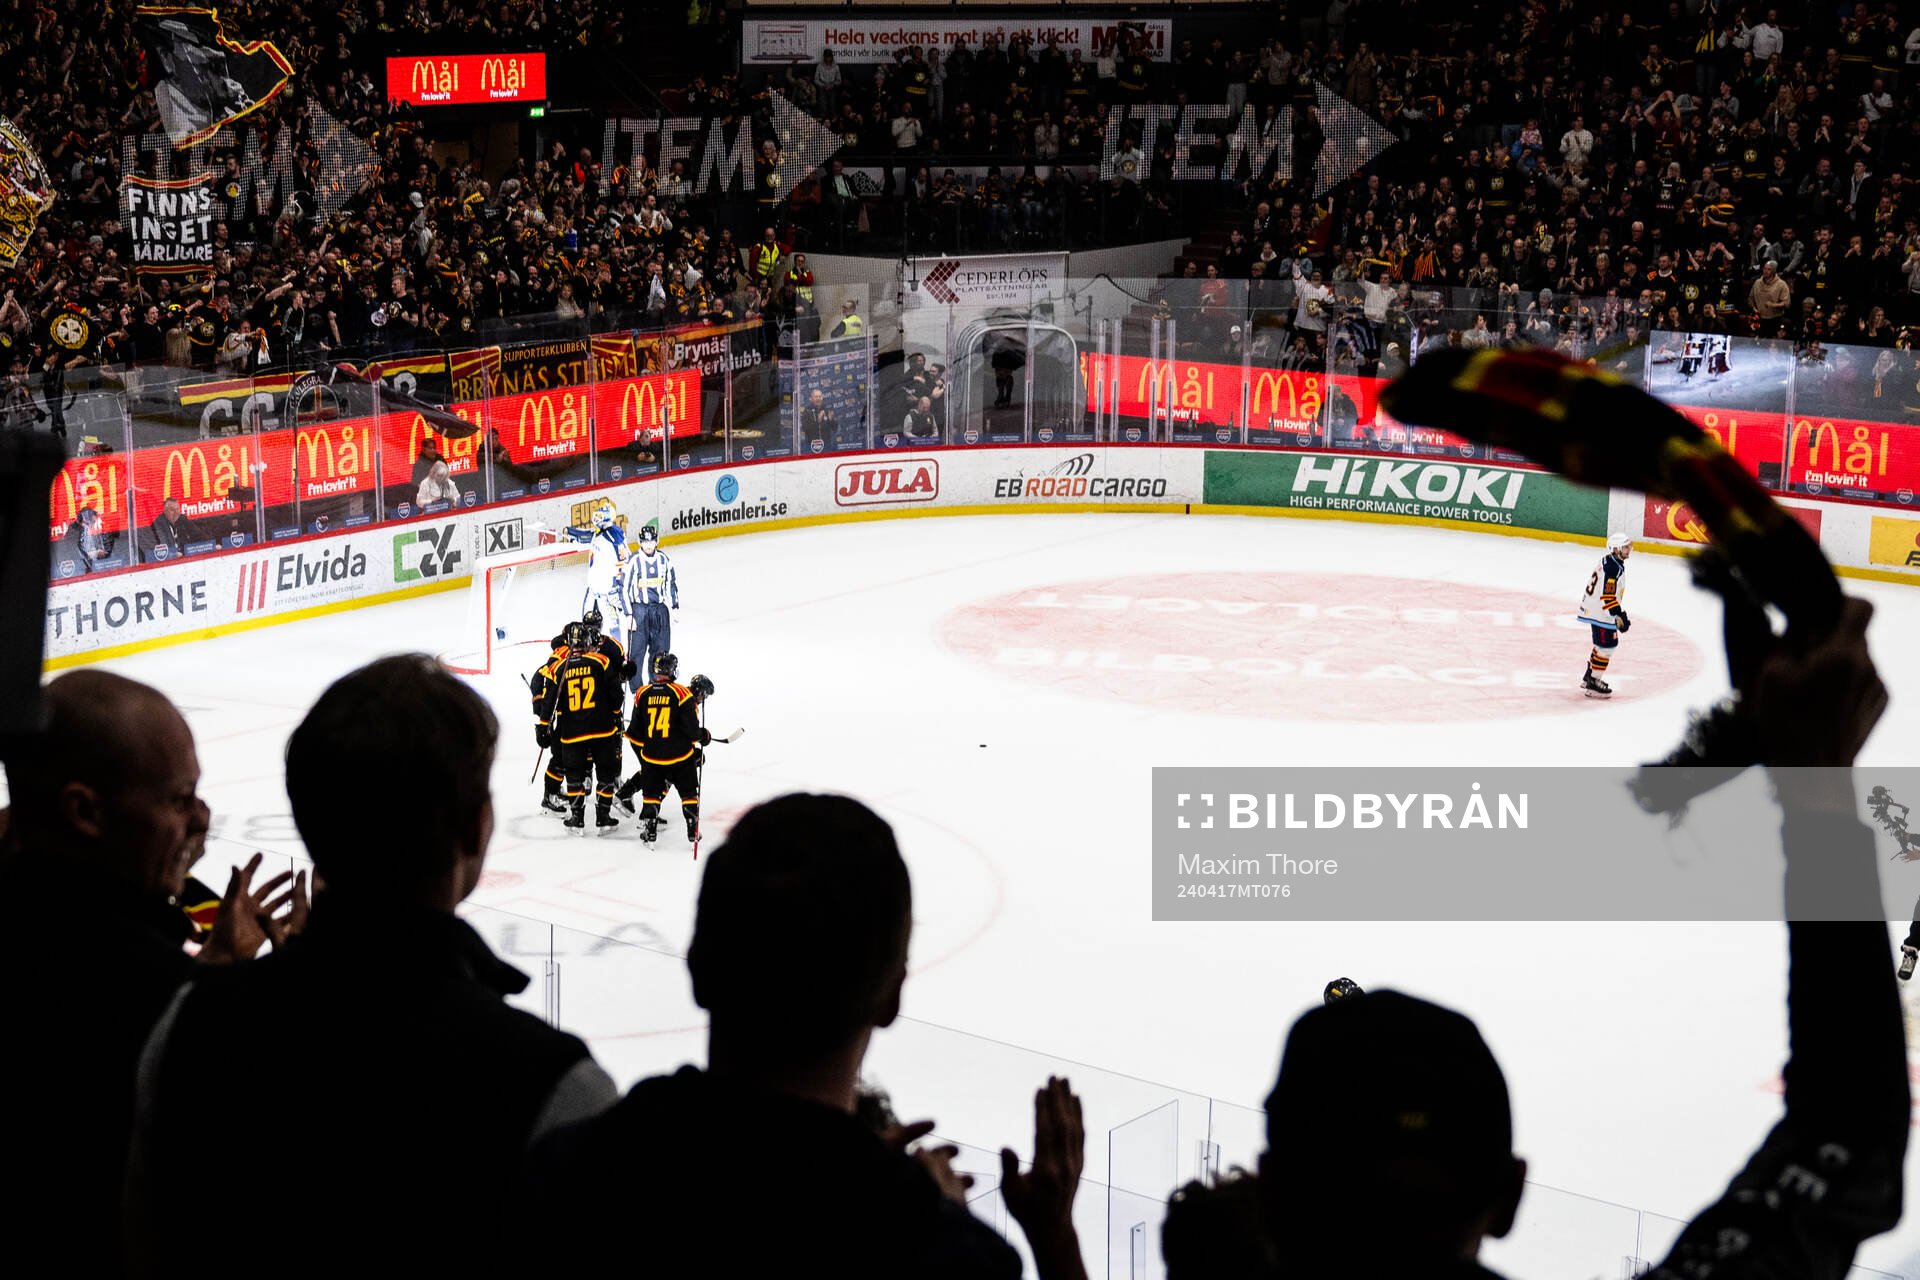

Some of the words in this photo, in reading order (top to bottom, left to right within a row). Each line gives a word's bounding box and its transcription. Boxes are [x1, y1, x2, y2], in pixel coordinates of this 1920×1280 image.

[825, 28, 864, 44] Hela
[869, 28, 939, 44] veckans
[944, 29, 977, 44] mat
[412, 61, 458, 92] Mål
[481, 58, 525, 90] Mål
[600, 116, 755, 198] ITEM
[1100, 104, 1292, 180] ITEM
[128, 187, 211, 217] FINNS
[130, 214, 212, 244] INGET
[955, 267, 1048, 286] CEDERLÖFS
[503, 341, 587, 363] SUPPORTERKLUBBEN
[674, 337, 727, 361] Brynäs
[1138, 361, 1214, 410] Mål
[1254, 372, 1321, 419] Må
[519, 393, 587, 446] Mål
[622, 379, 686, 430] Mål
[1285, 418, 1310, 432] lovin'
[292, 426, 369, 485] Mål
[547, 441, 568, 456] lovin'
[1790, 420, 1888, 475] Mål
[163, 444, 248, 501] Mål
[323, 477, 347, 493] lovin'
[839, 467, 934, 497] JULA
[1824, 472, 1857, 486] lovin'
[1859, 474, 1868, 487] it
[671, 496, 788, 531] ekfeltsmaleri.se
[1290, 496, 1323, 508] HIGH
[1326, 498, 1420, 515] PERFORMANCE
[1424, 505, 1469, 520] POWER
[1473, 510, 1512, 525] TOOLS
[488, 524, 521, 553] XL
[276, 544, 367, 592] Elvida
[48, 580, 208, 639] THORNE
[568, 676, 596, 712] 52
[647, 707, 671, 738] 74
